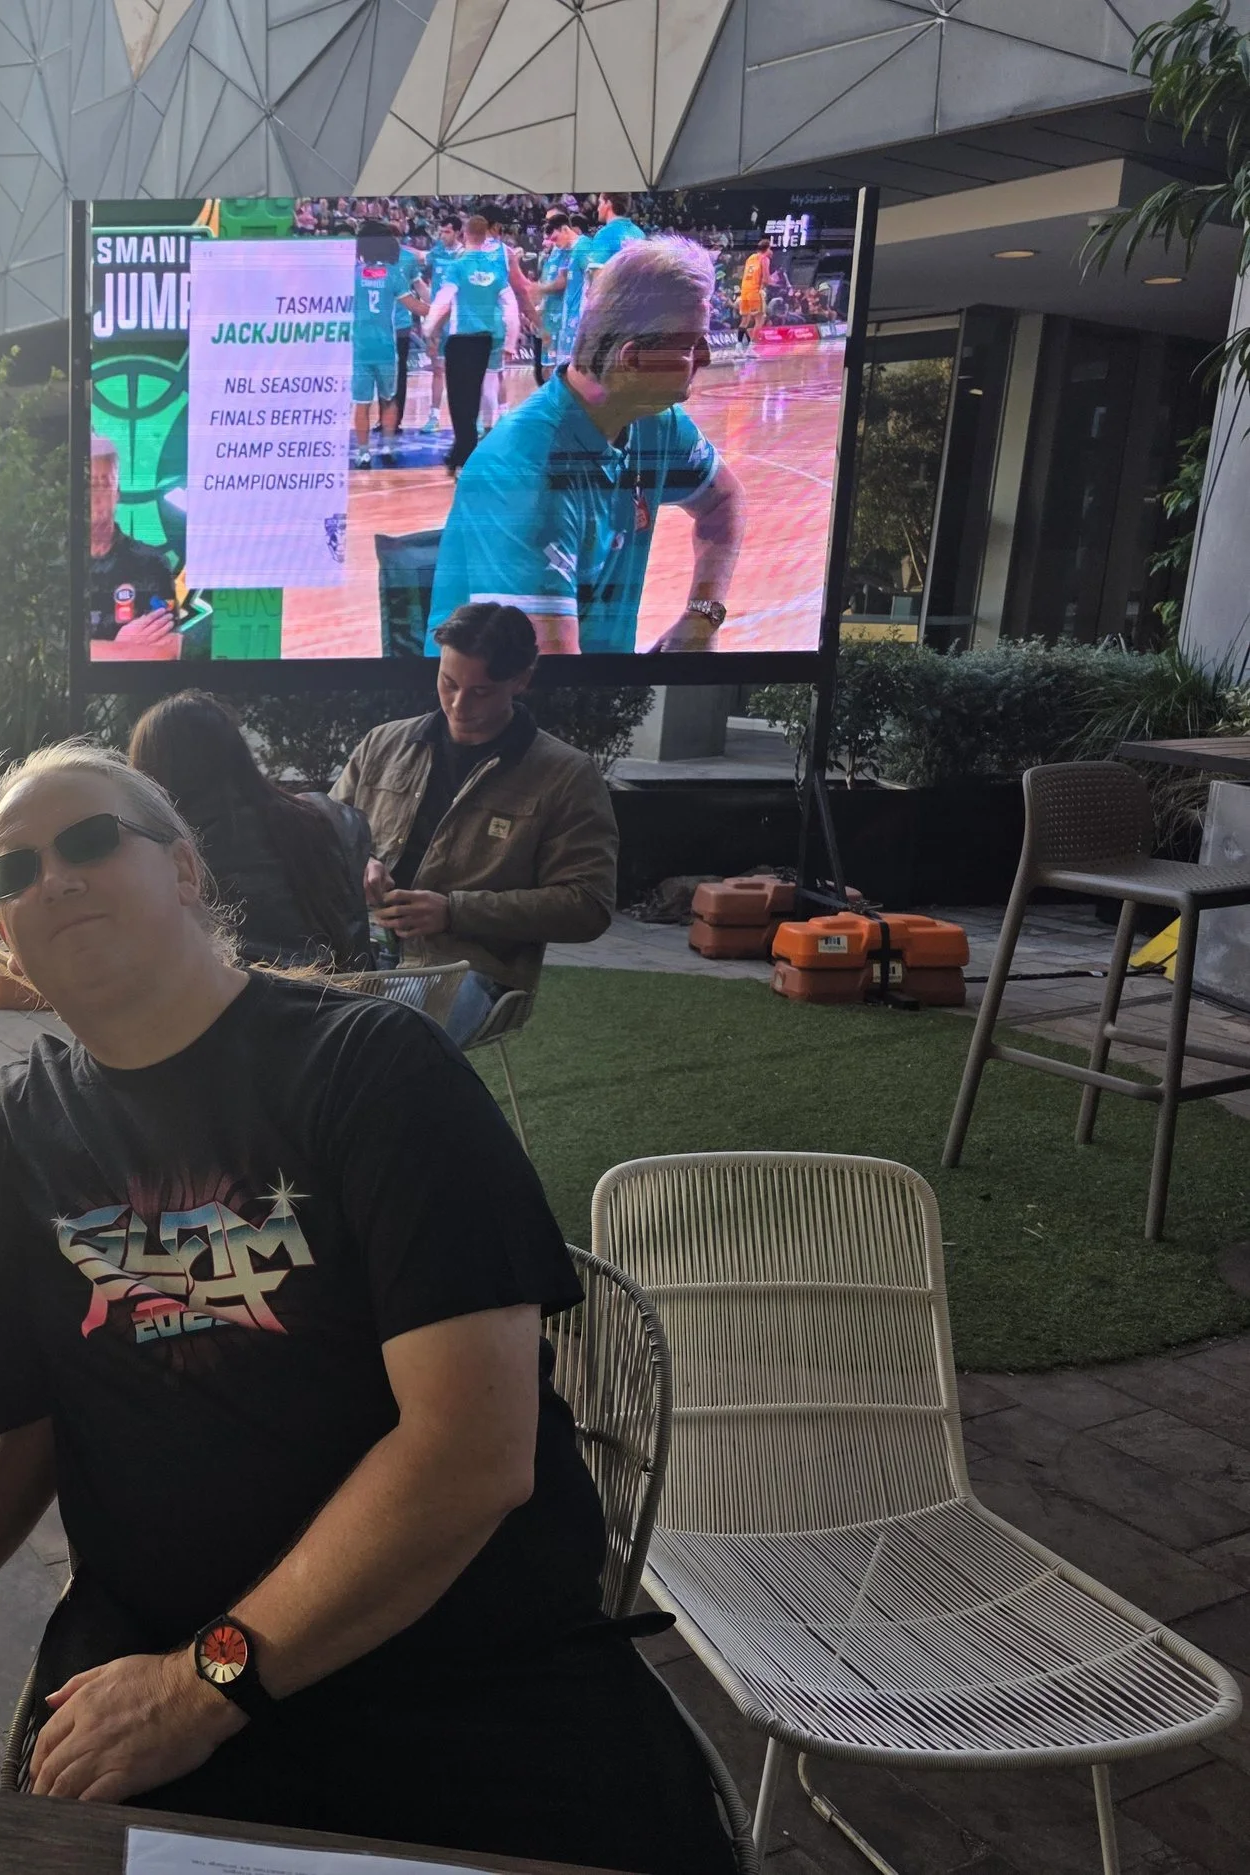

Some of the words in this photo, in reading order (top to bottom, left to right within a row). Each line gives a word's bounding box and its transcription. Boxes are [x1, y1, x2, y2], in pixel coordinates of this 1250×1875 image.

[224, 377, 256, 394] NBL
[260, 376, 338, 393] SEASONS:
[209, 410, 266, 426] FINALS
[270, 409, 337, 426] BERTHS:
[216, 442, 274, 459] CHAMP
[277, 441, 336, 458] SERIES:
[130, 1309, 237, 1344] 202
